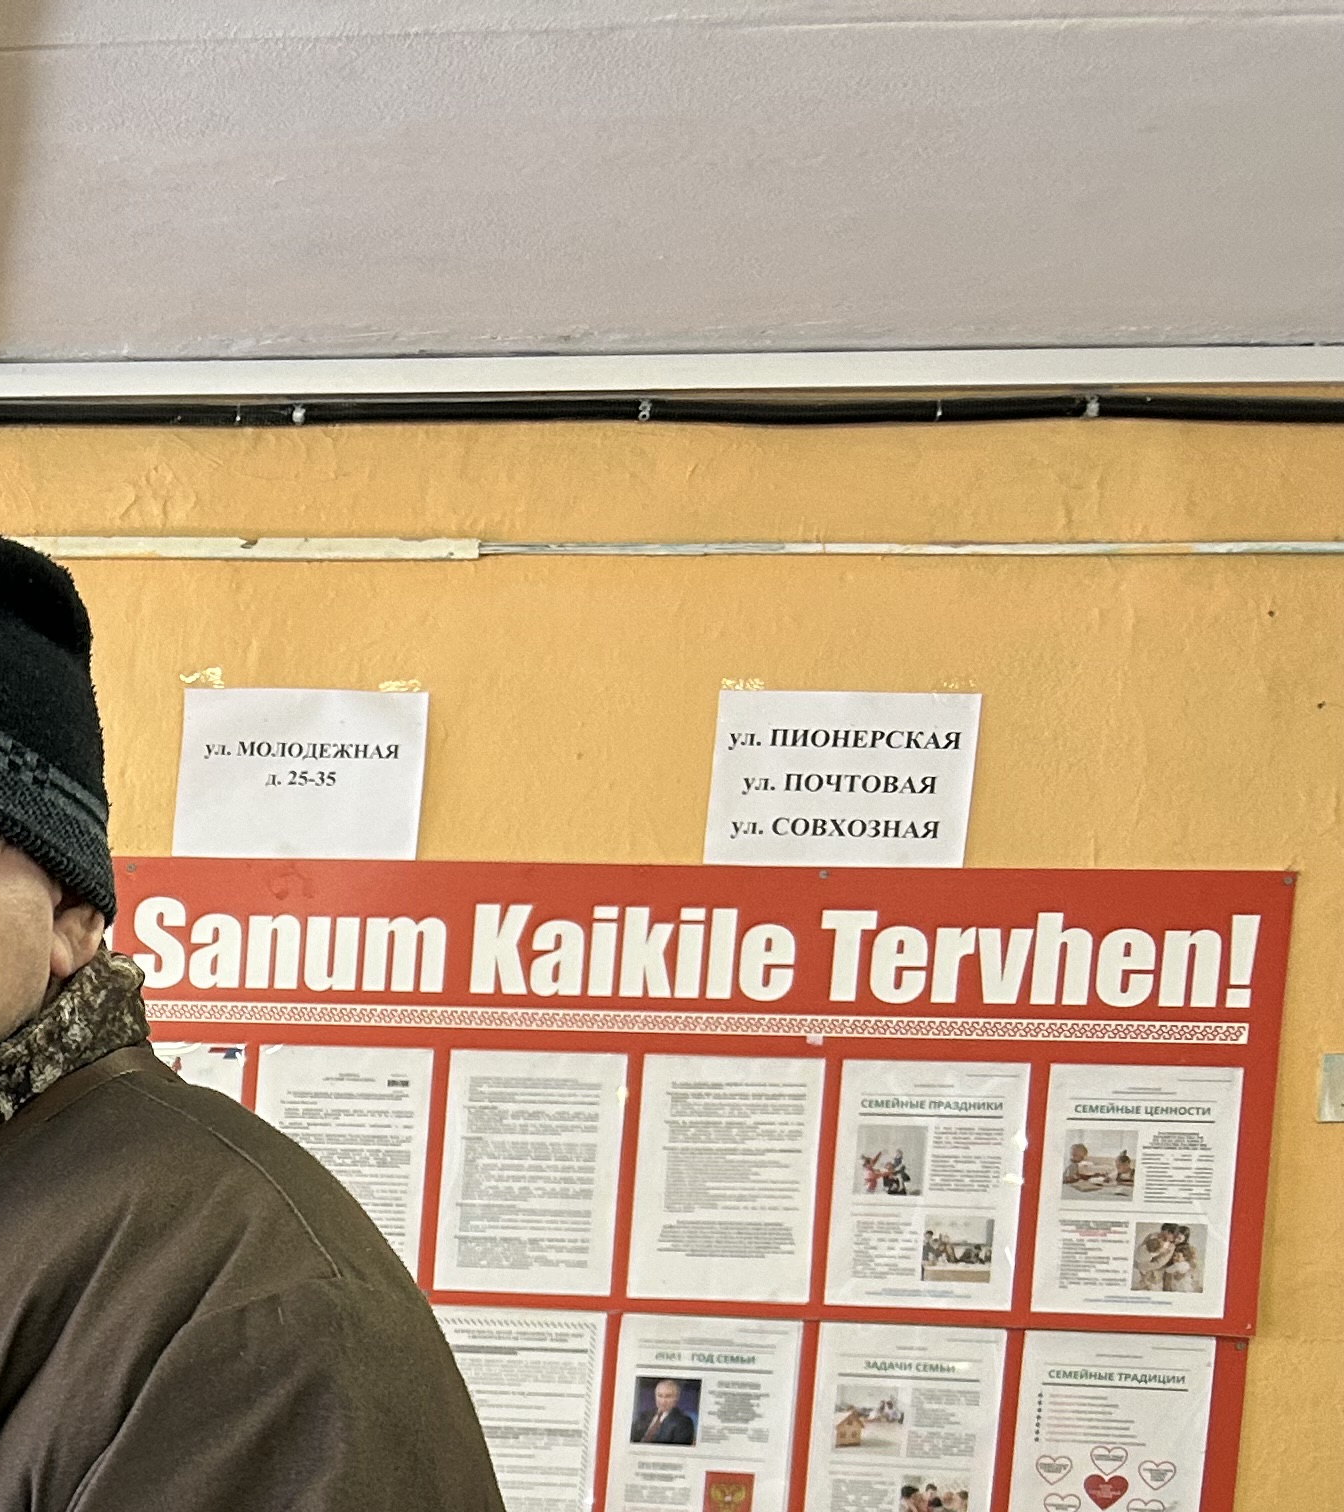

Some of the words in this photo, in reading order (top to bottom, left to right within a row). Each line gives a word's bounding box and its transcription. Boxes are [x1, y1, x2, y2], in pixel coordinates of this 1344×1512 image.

[728, 732, 762, 751] ул.
[769, 728, 962, 750] ПИОНЕРСКАЯ
[203, 743, 232, 759] ул.
[236, 741, 400, 760] МОЛОДЕЖНАЯ
[265, 773, 282, 787] д.
[287, 770, 337, 787] 25-35
[741, 776, 776, 795] ул.
[783, 773, 937, 794] ПОЧТОВАЯ
[730, 820, 764, 839] ул.
[771, 817, 940, 839] СОВХОЗНАЯ
[132, 895, 447, 994] Sanum
[468, 902, 795, 1001] Kaikile
[820, 909, 1261, 1009] Tervhen!
[860, 1098, 926, 1112] СЕМЕЙНЫЕ
[928, 1100, 1004, 1113] ПРАЗДНИКИ
[1074, 1102, 1142, 1116] СЕМЕЙНЫЕ
[1144, 1104, 1212, 1117] ЦЕННОСТИ
[863, 1360, 912, 1372] ЗАДАЧИ
[915, 1363, 955, 1373] СЕМЬИ
[1048, 1369, 1115, 1382] СЕМЕЙНЫЕ
[1117, 1372, 1186, 1385] ТРАДИЦИИ
